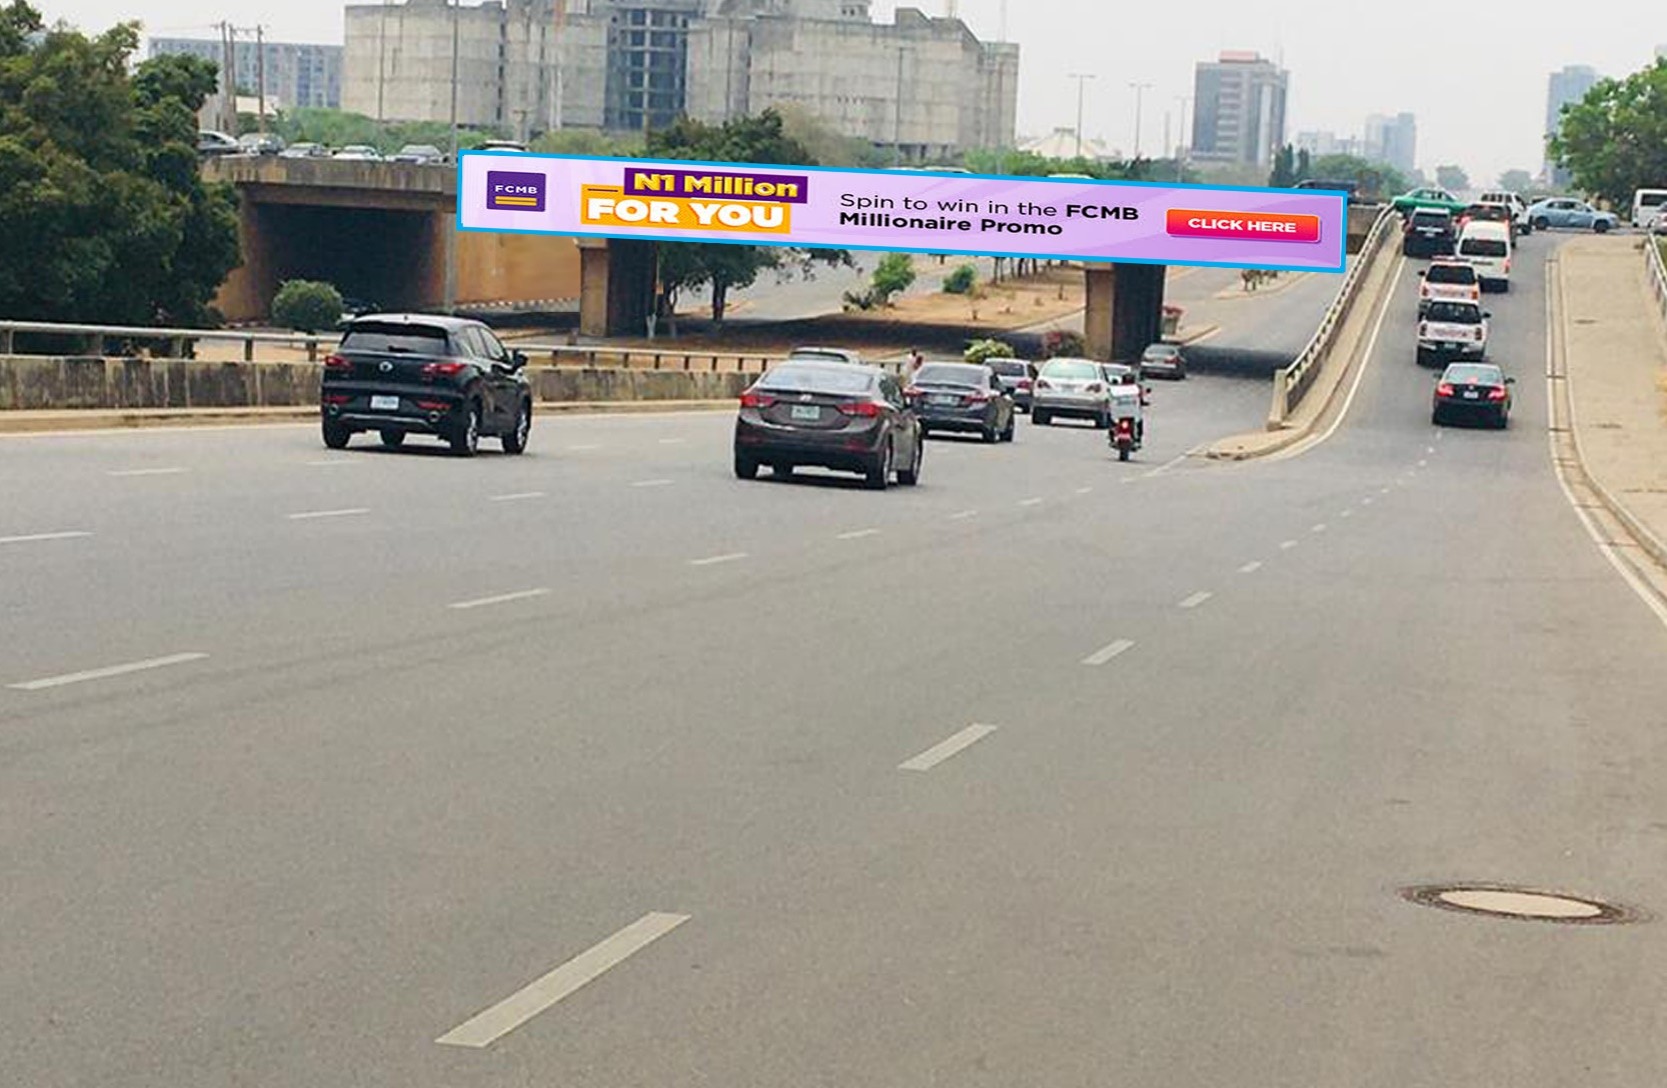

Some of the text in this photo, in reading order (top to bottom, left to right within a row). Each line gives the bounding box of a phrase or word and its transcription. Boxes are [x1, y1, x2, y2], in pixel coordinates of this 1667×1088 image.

[495, 185, 538, 194] FCMB
[684, 175, 799, 198] Million
[587, 198, 784, 228] FOR YOU
[840, 193, 1139, 220] Spin to win in the FCMB
[839, 212, 1063, 235] Millionaire Promo
[1188, 218, 1297, 233] CLICK HERE
